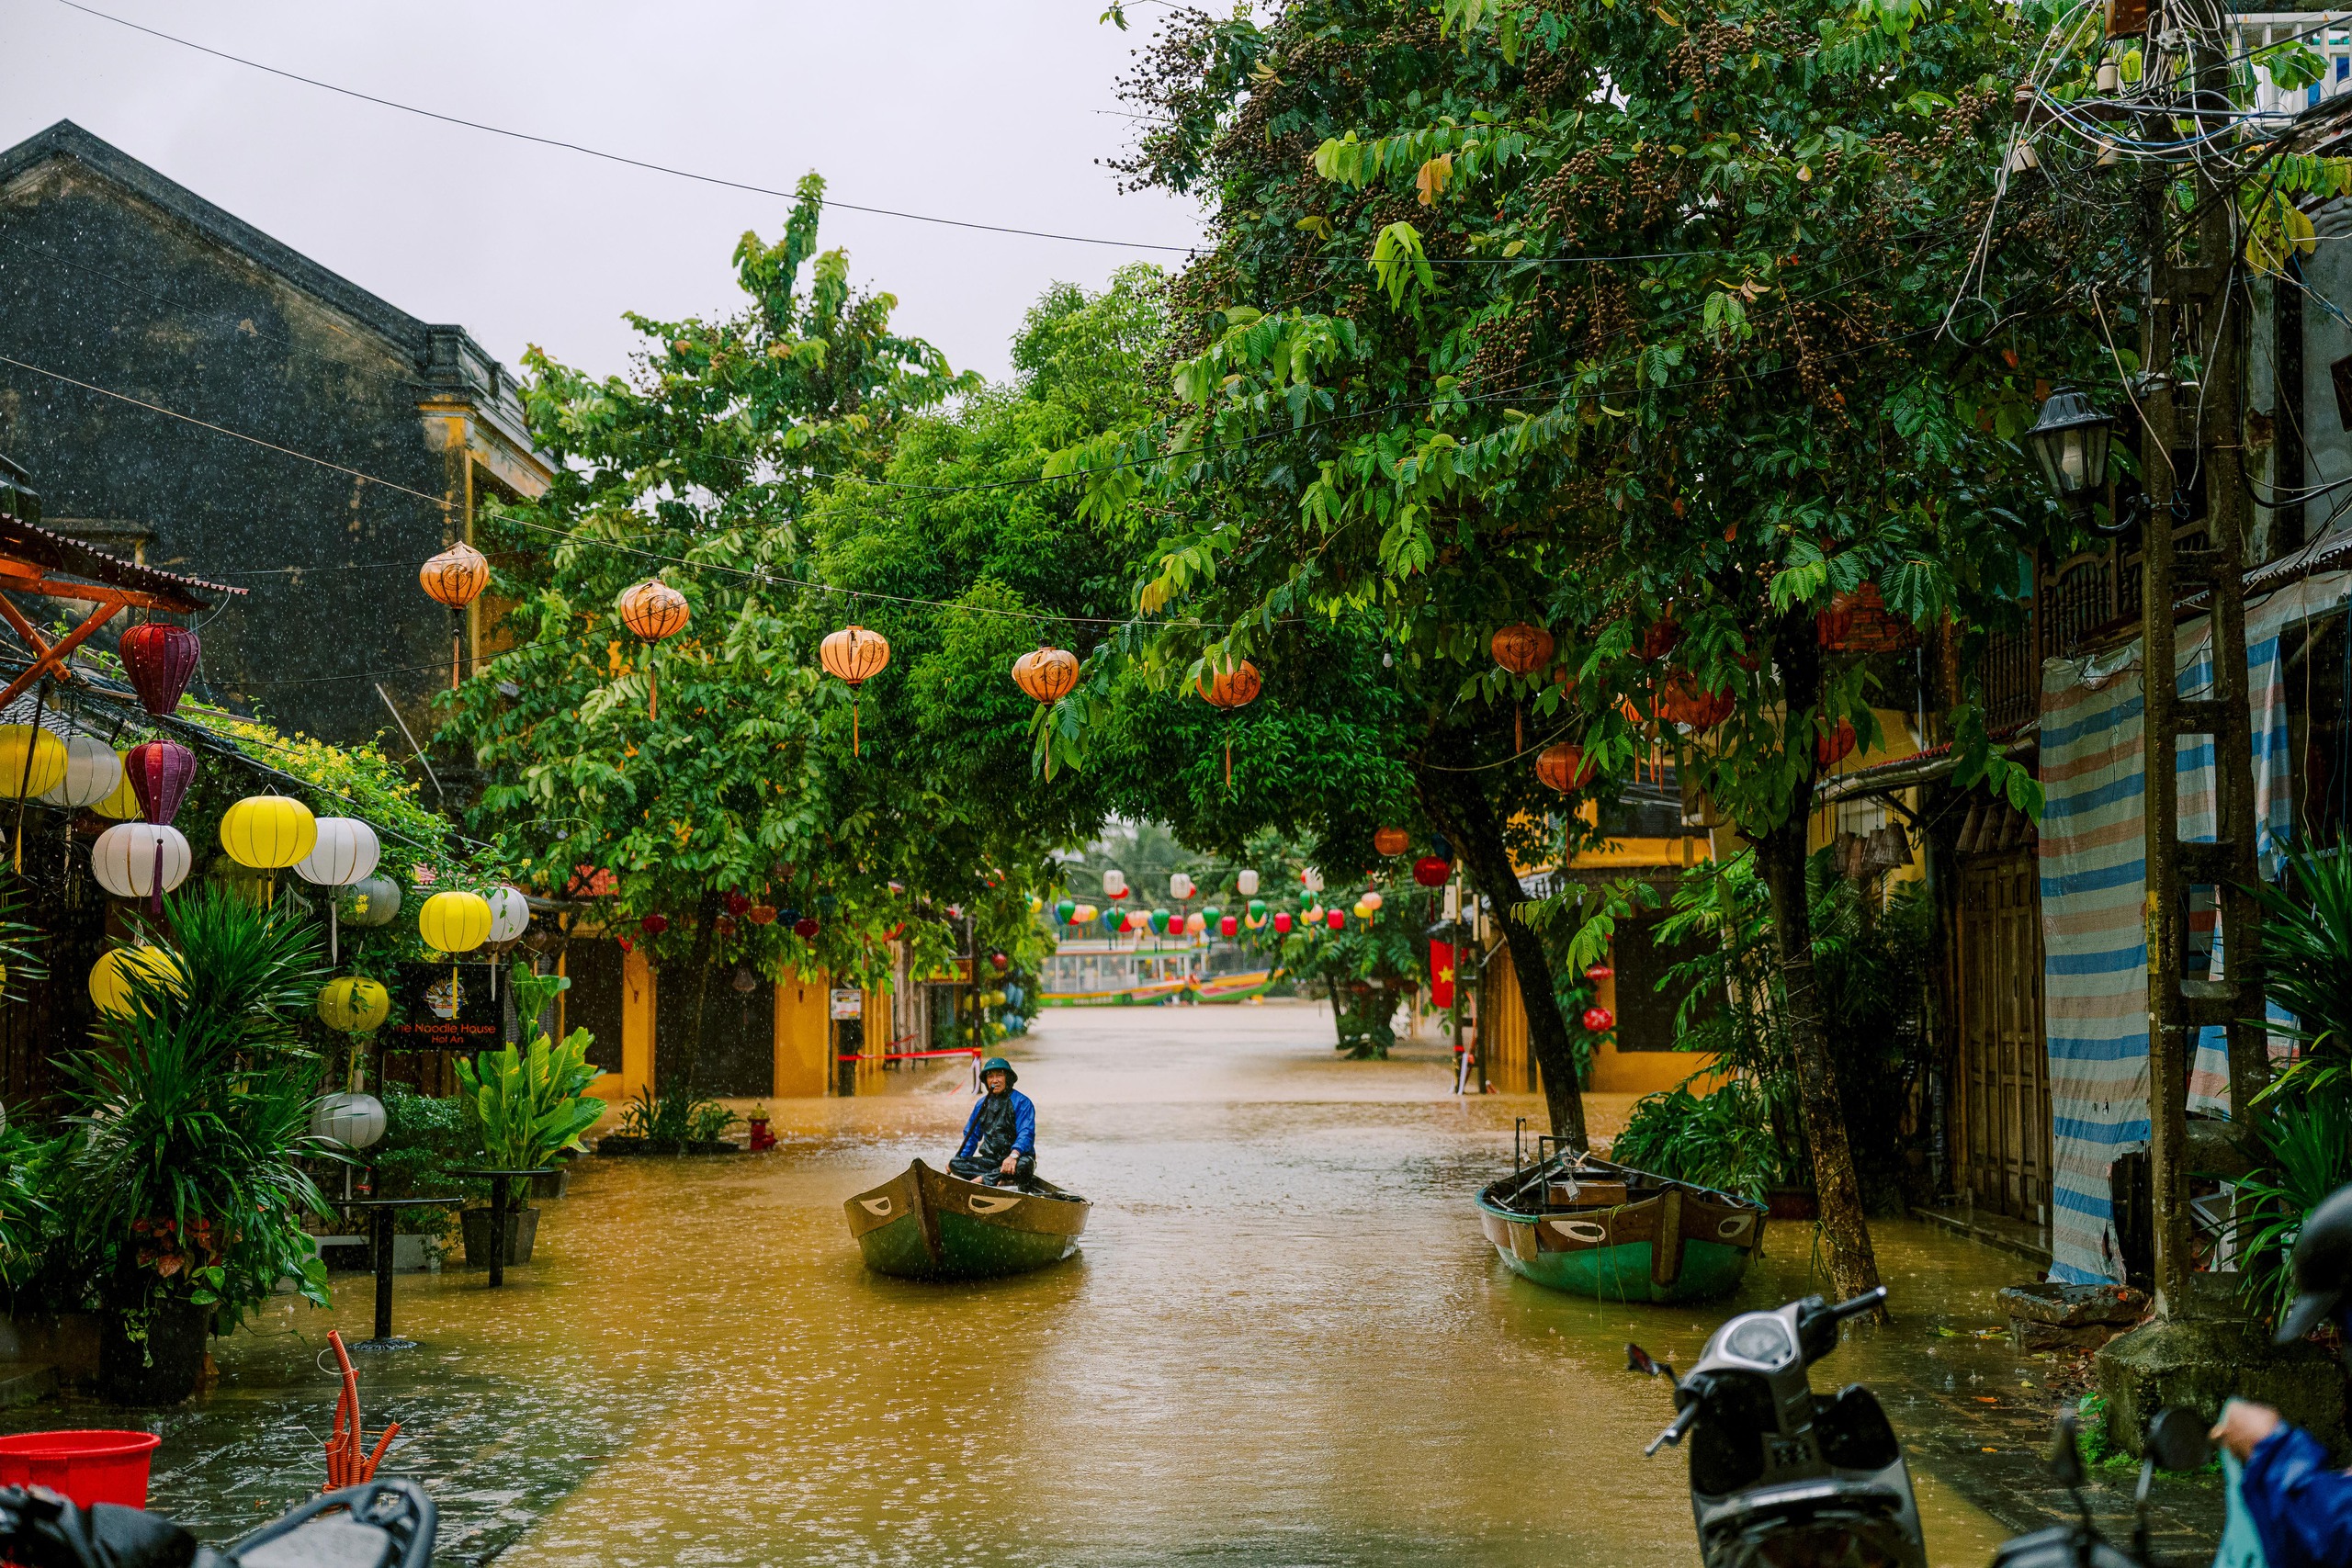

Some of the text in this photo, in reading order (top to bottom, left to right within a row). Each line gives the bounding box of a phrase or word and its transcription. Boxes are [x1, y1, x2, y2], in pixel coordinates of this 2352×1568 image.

[414, 1023, 458, 1033] Noodle
[460, 1023, 496, 1034] House
[449, 1035, 464, 1043] An
